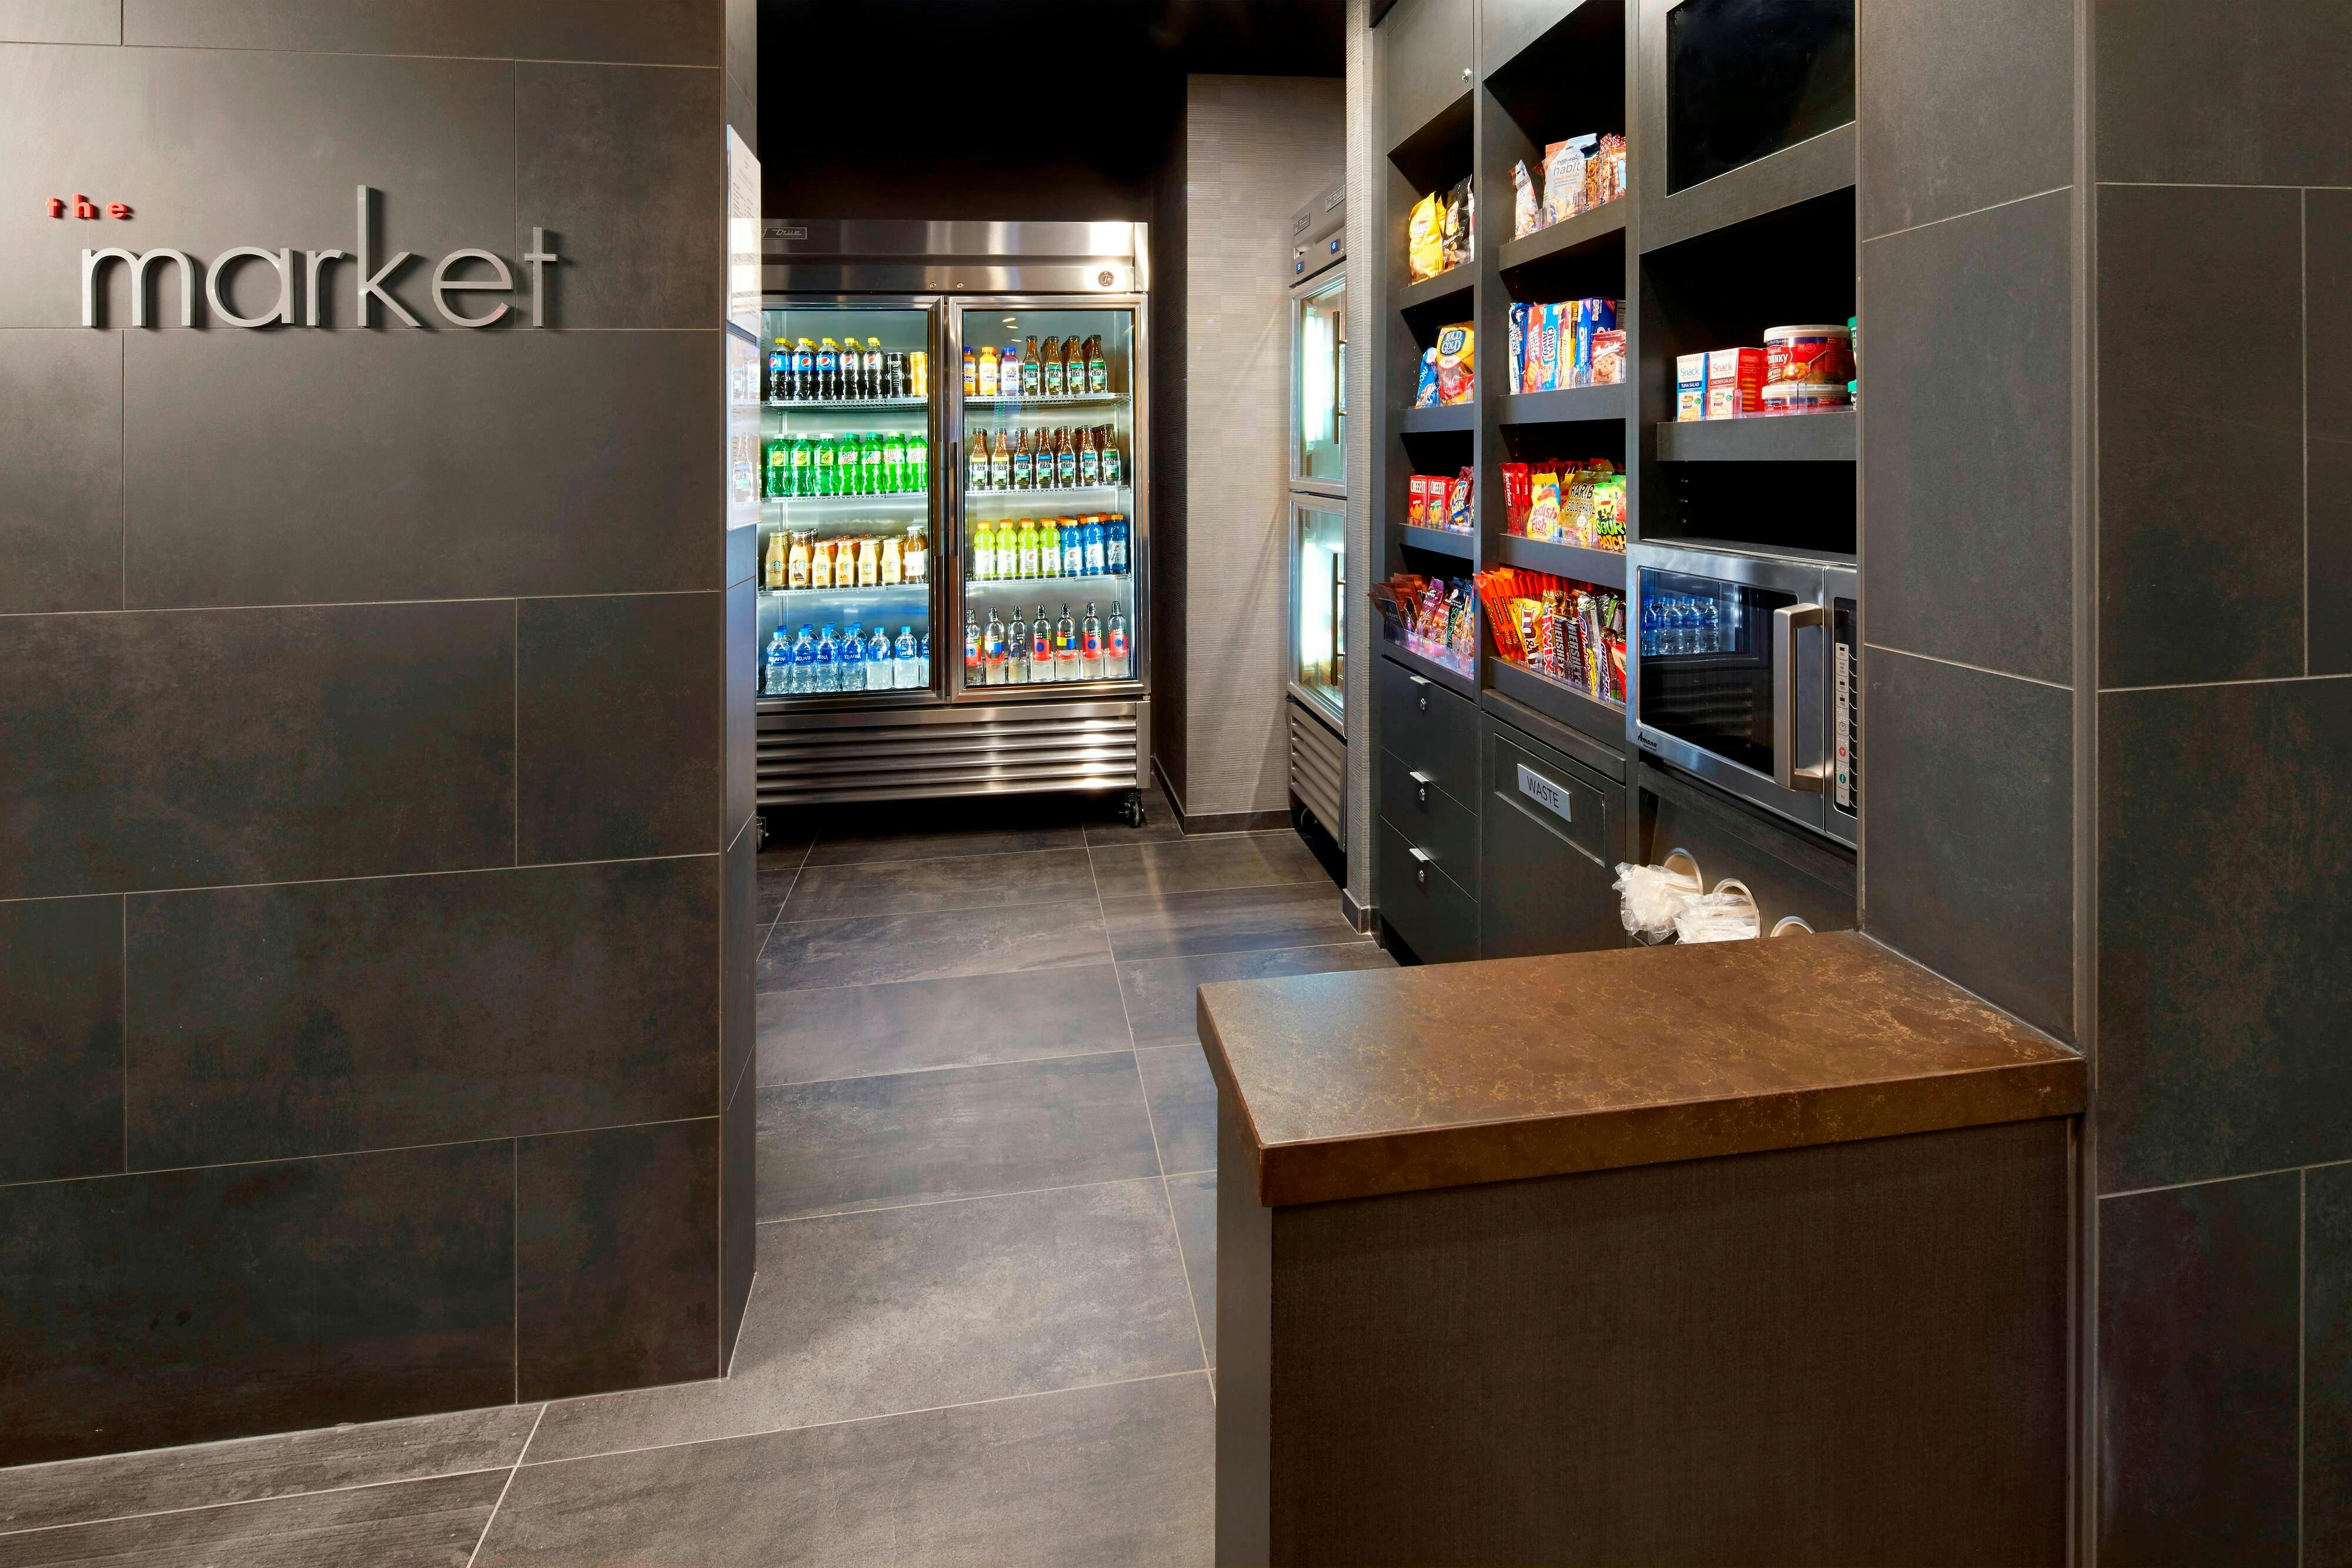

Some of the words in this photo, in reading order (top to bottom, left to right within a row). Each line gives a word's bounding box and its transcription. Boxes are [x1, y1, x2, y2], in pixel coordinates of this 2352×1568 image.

[1553, 161, 1581, 176] habit
[46, 193, 128, 219] the
[82, 185, 559, 327] market
[1445, 330, 1462, 341] ROLD
[1441, 340, 1461, 353] GOLD
[1680, 367, 1699, 377] Snack
[1713, 363, 1732, 373] Snack
[1570, 482, 1595, 500] HARIB
[1531, 517, 1547, 533] Fish
[1596, 518, 1625, 535] SOUR
[1598, 534, 1626, 550] PATCH
[1448, 607, 1458, 648] STACHIOS
[1542, 609, 1555, 674] TWIX
[1638, 731, 1657, 747] Amana
[1526, 775, 1559, 808] WASTE
